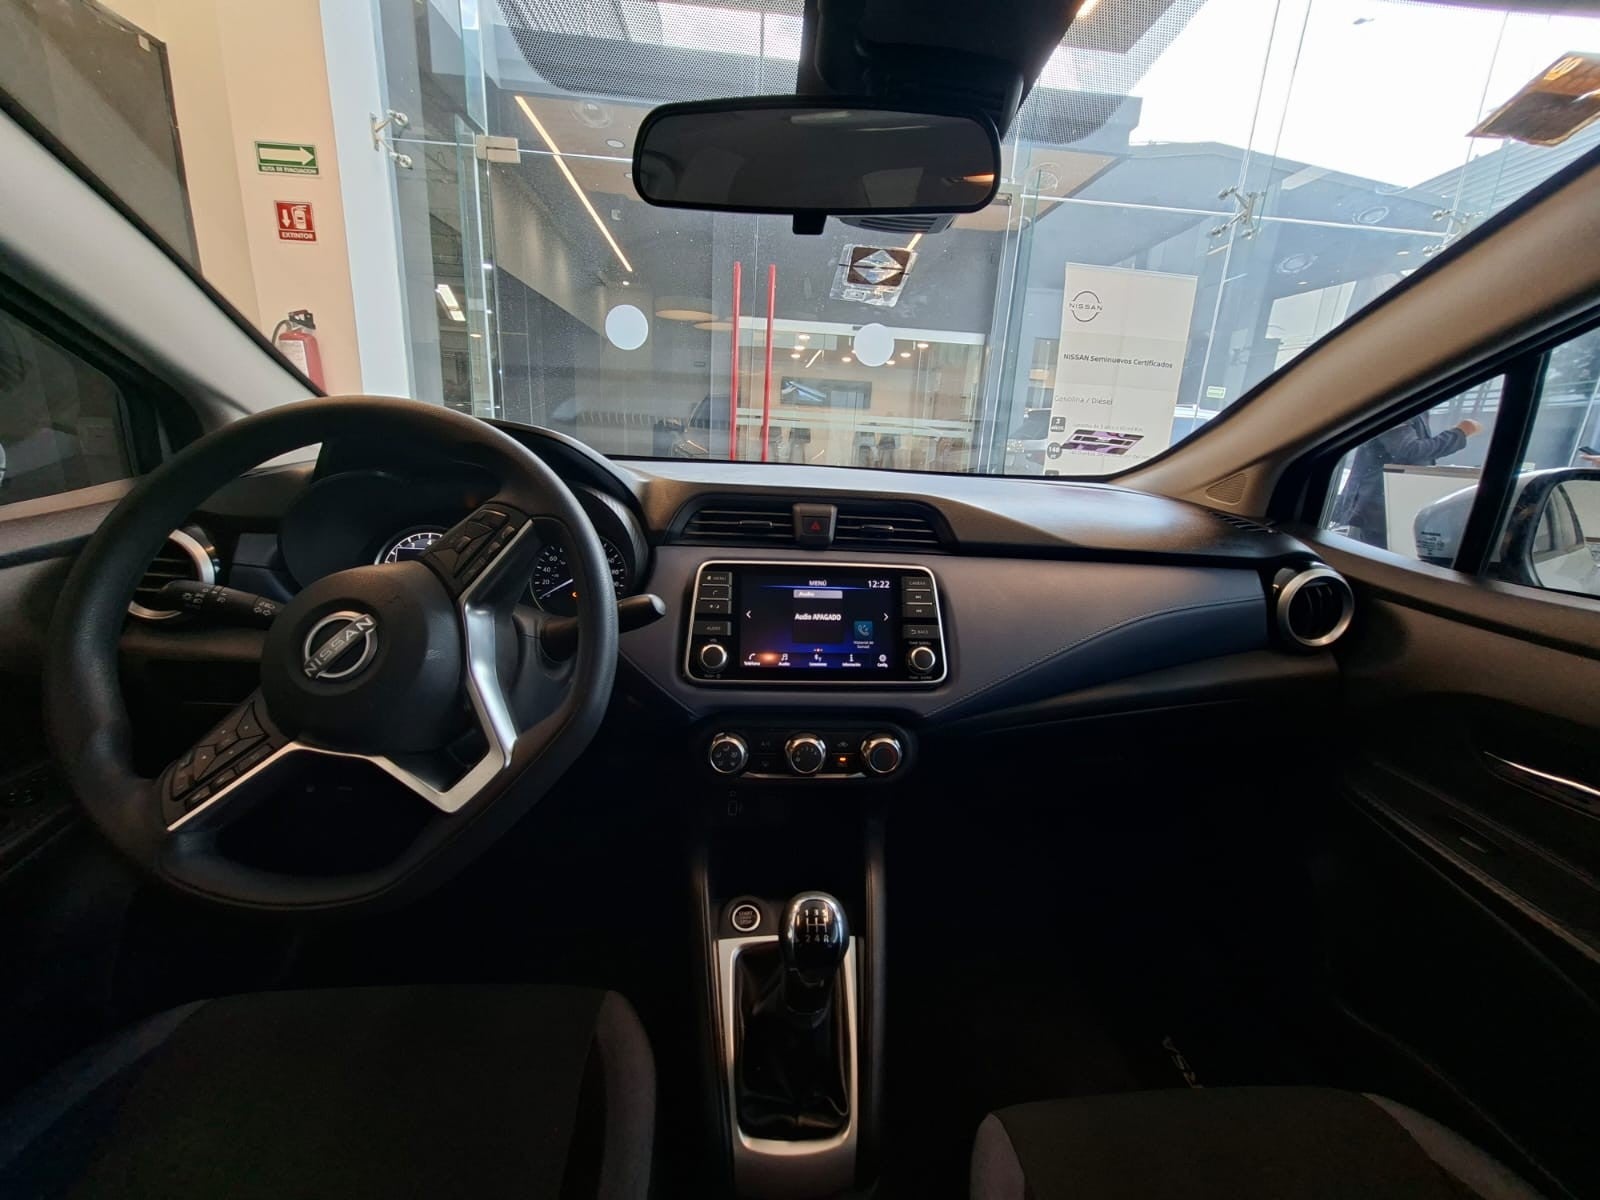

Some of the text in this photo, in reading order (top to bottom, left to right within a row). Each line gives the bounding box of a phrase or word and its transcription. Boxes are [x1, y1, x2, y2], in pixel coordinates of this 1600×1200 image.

[282, 232, 313, 240] EXTINTOR
[1069, 303, 1103, 311] NISSAN
[1064, 353, 1173, 369] NISSAN Seminuevos Certificados
[867, 580, 890, 589] 12:22
[795, 613, 842, 622] Audio APAGADO
[304, 615, 375, 678] NISSAN
[823, 934, 829, 943] R
